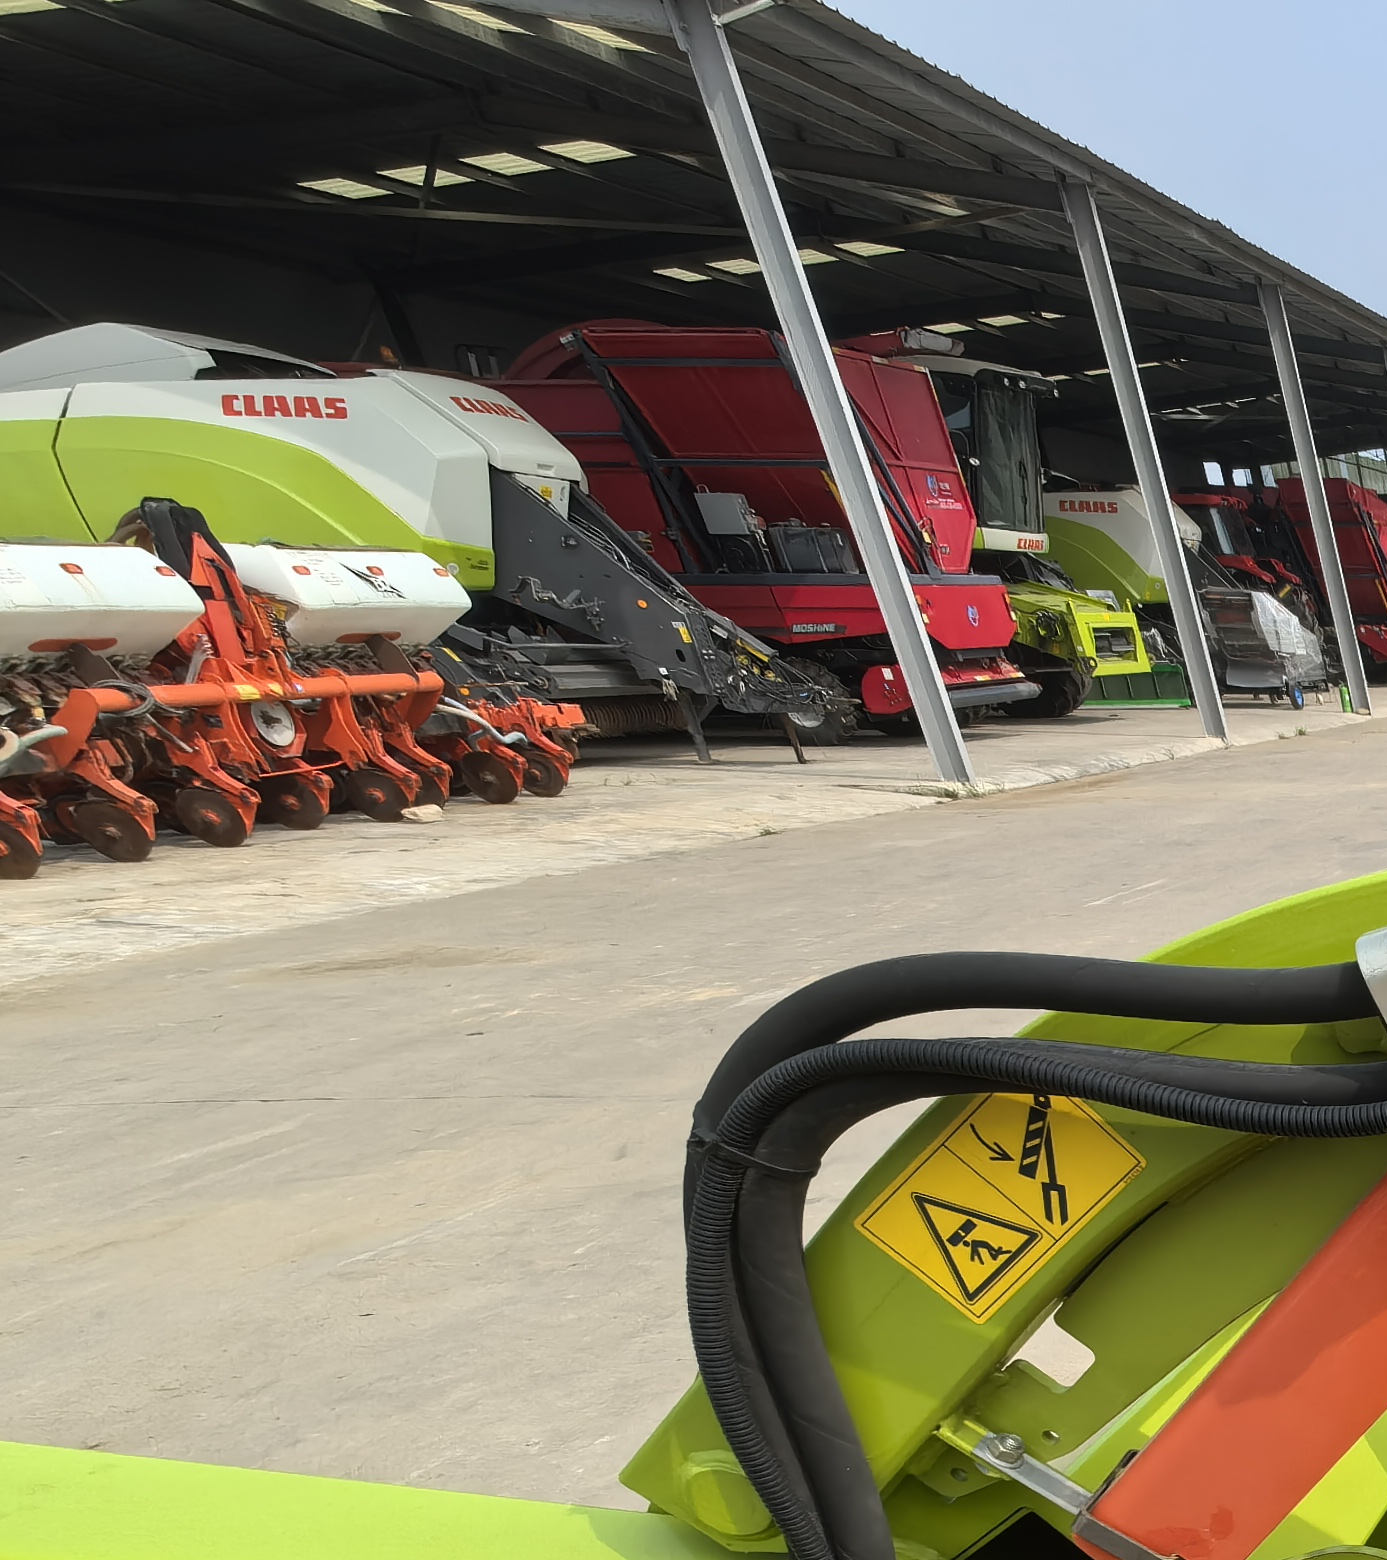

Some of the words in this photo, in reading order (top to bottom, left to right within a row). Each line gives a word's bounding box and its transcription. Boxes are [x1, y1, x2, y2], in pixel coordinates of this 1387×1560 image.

[221, 394, 348, 419] CLAAS
[449, 396, 530, 422] CLAAS
[1060, 500, 1118, 513] CLAAS
[1017, 538, 1044, 551] CLAAS
